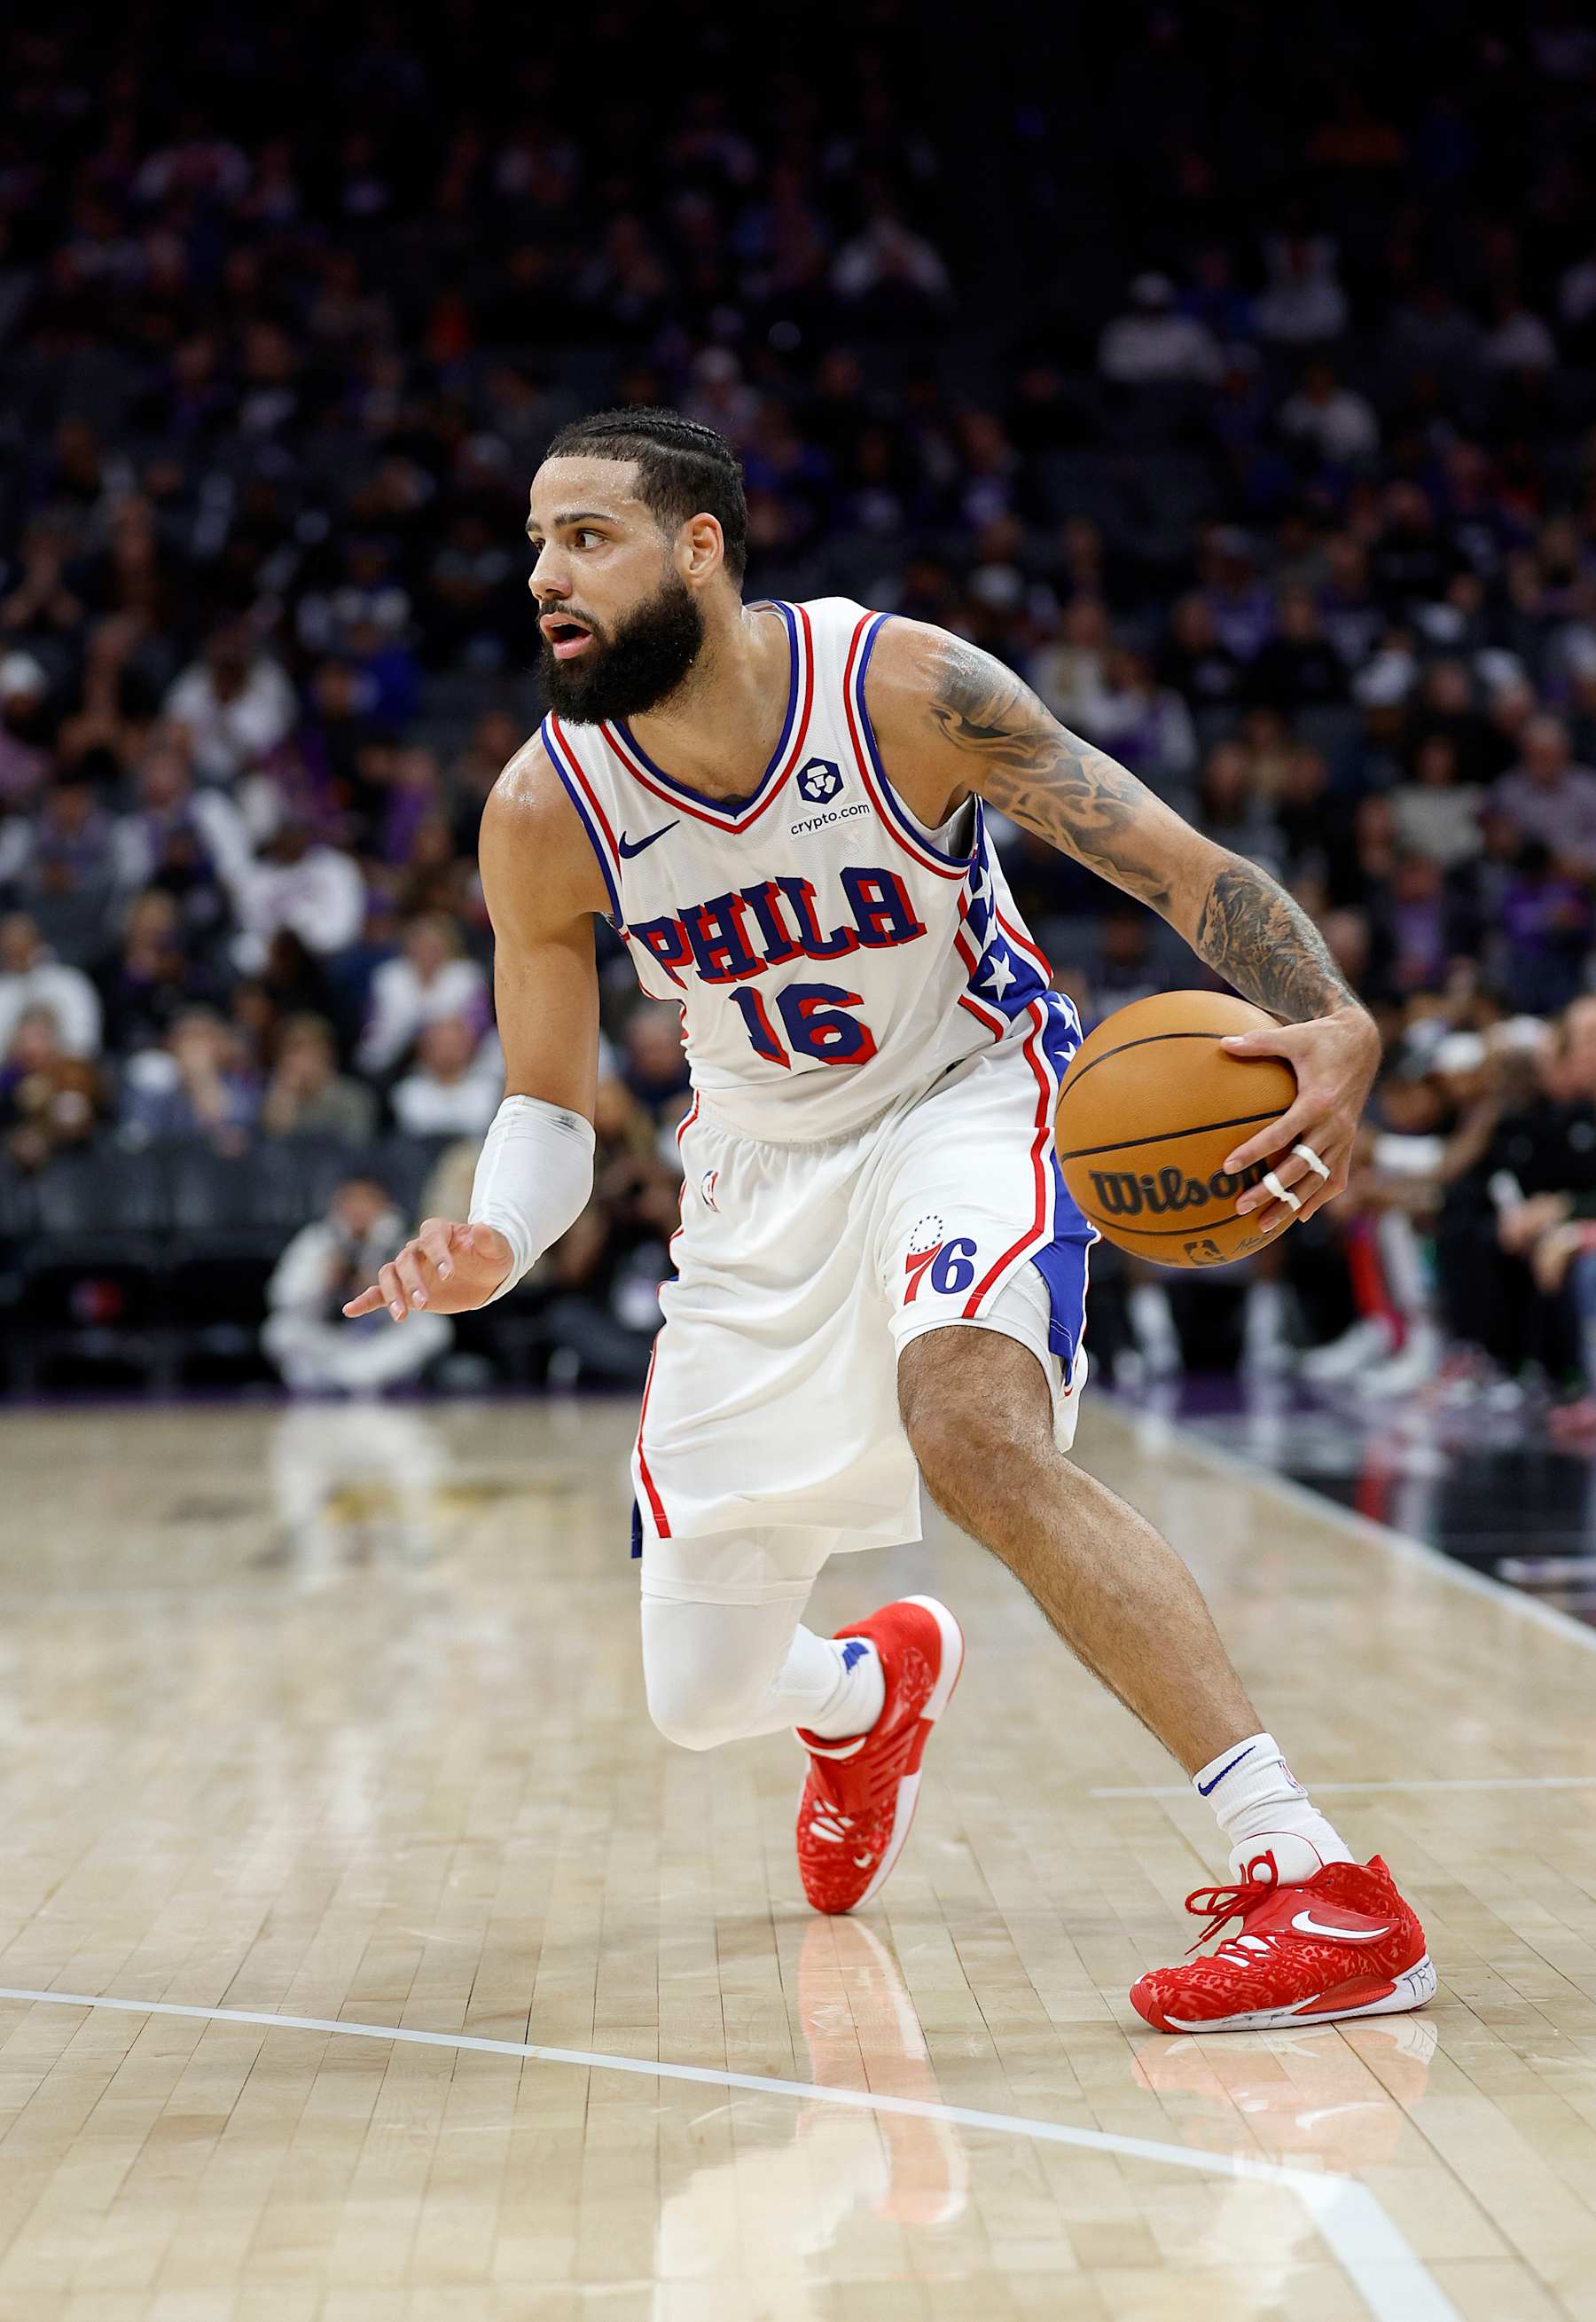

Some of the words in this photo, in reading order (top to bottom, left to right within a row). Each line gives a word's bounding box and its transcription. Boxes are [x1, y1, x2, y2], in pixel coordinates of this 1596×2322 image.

[791, 804, 870, 835] crypto.com
[627, 867, 927, 989] PHILA
[729, 983, 878, 1070] 16
[904, 1237, 977, 1306] 76
